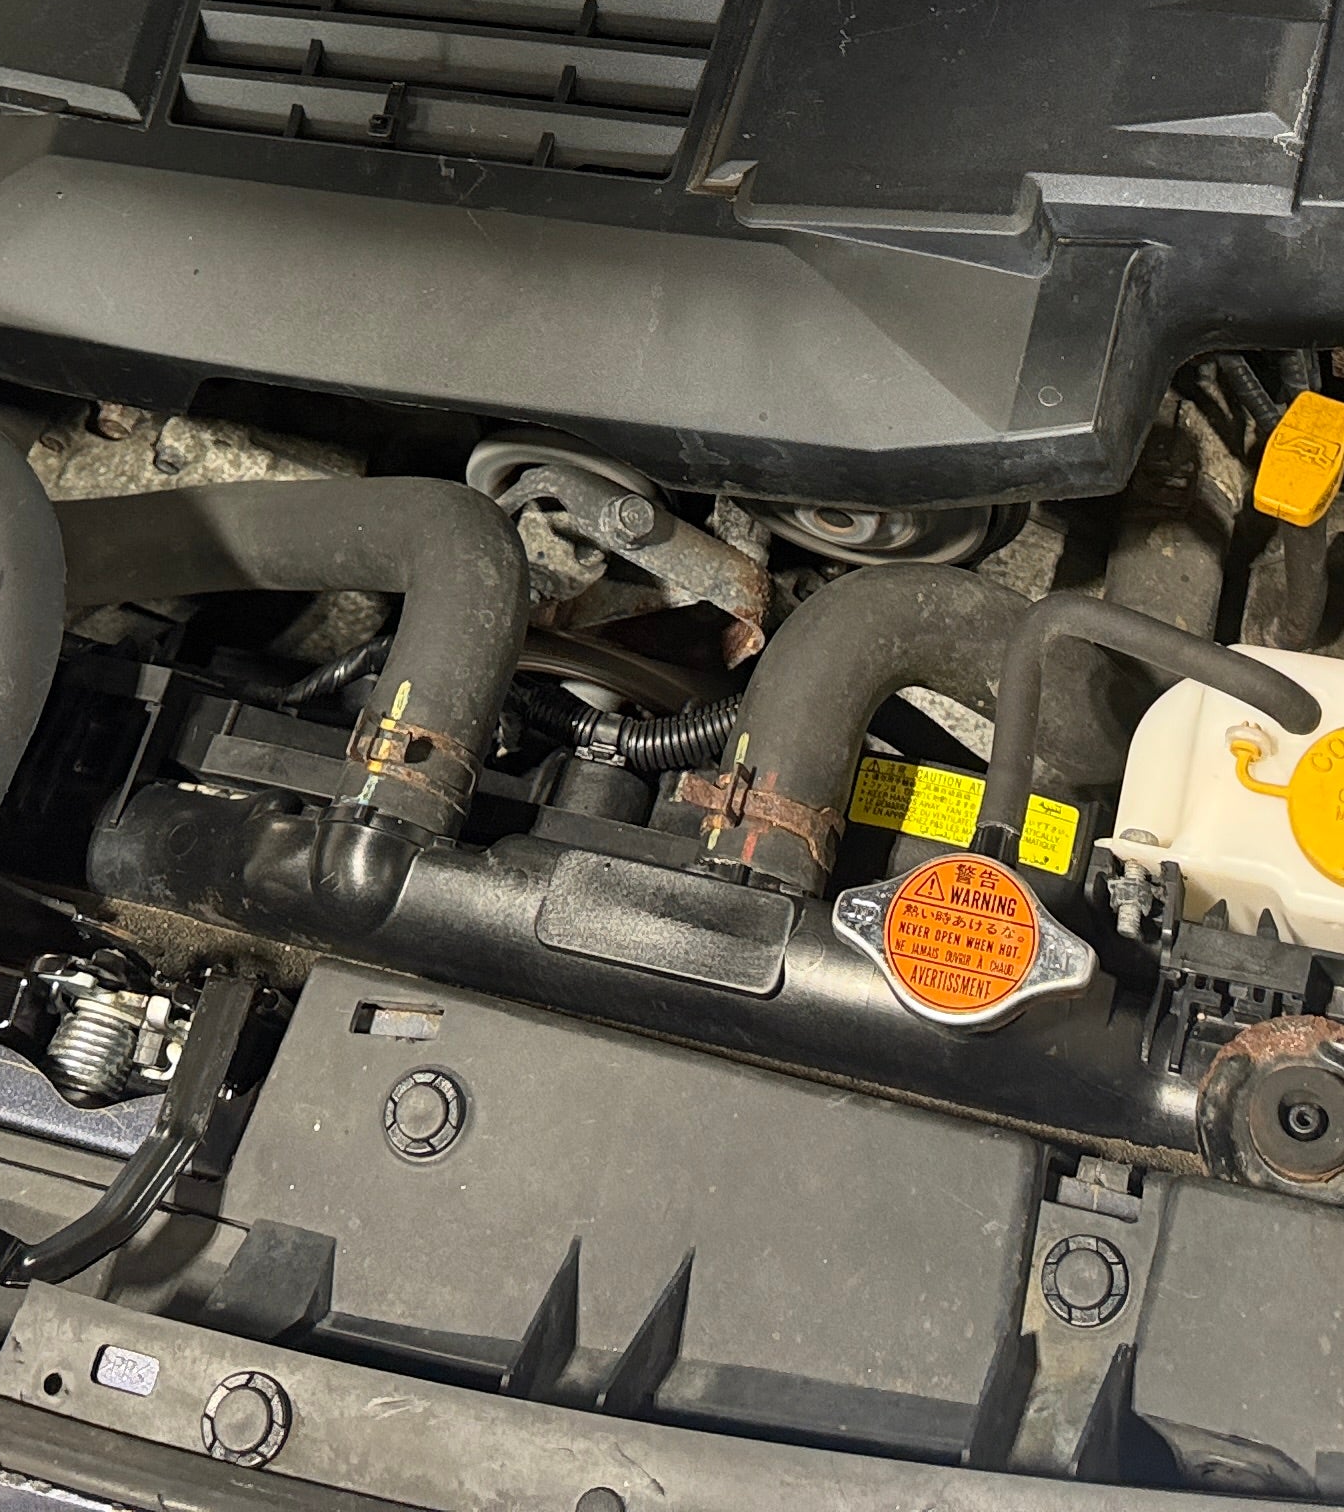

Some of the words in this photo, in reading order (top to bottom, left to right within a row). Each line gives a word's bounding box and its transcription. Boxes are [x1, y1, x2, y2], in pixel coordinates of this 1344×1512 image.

[915, 768, 963, 788] CAUTION
[955, 863, 1000, 891] 警告
[949, 885, 1018, 918] WARNING
[894, 938, 907, 951] NE
[910, 941, 940, 959] JAMAIS
[897, 921, 930, 941] NEVER
[934, 929, 961, 947] OPEN
[965, 936, 994, 955] WHEN
[998, 943, 1022, 960] HOT.
